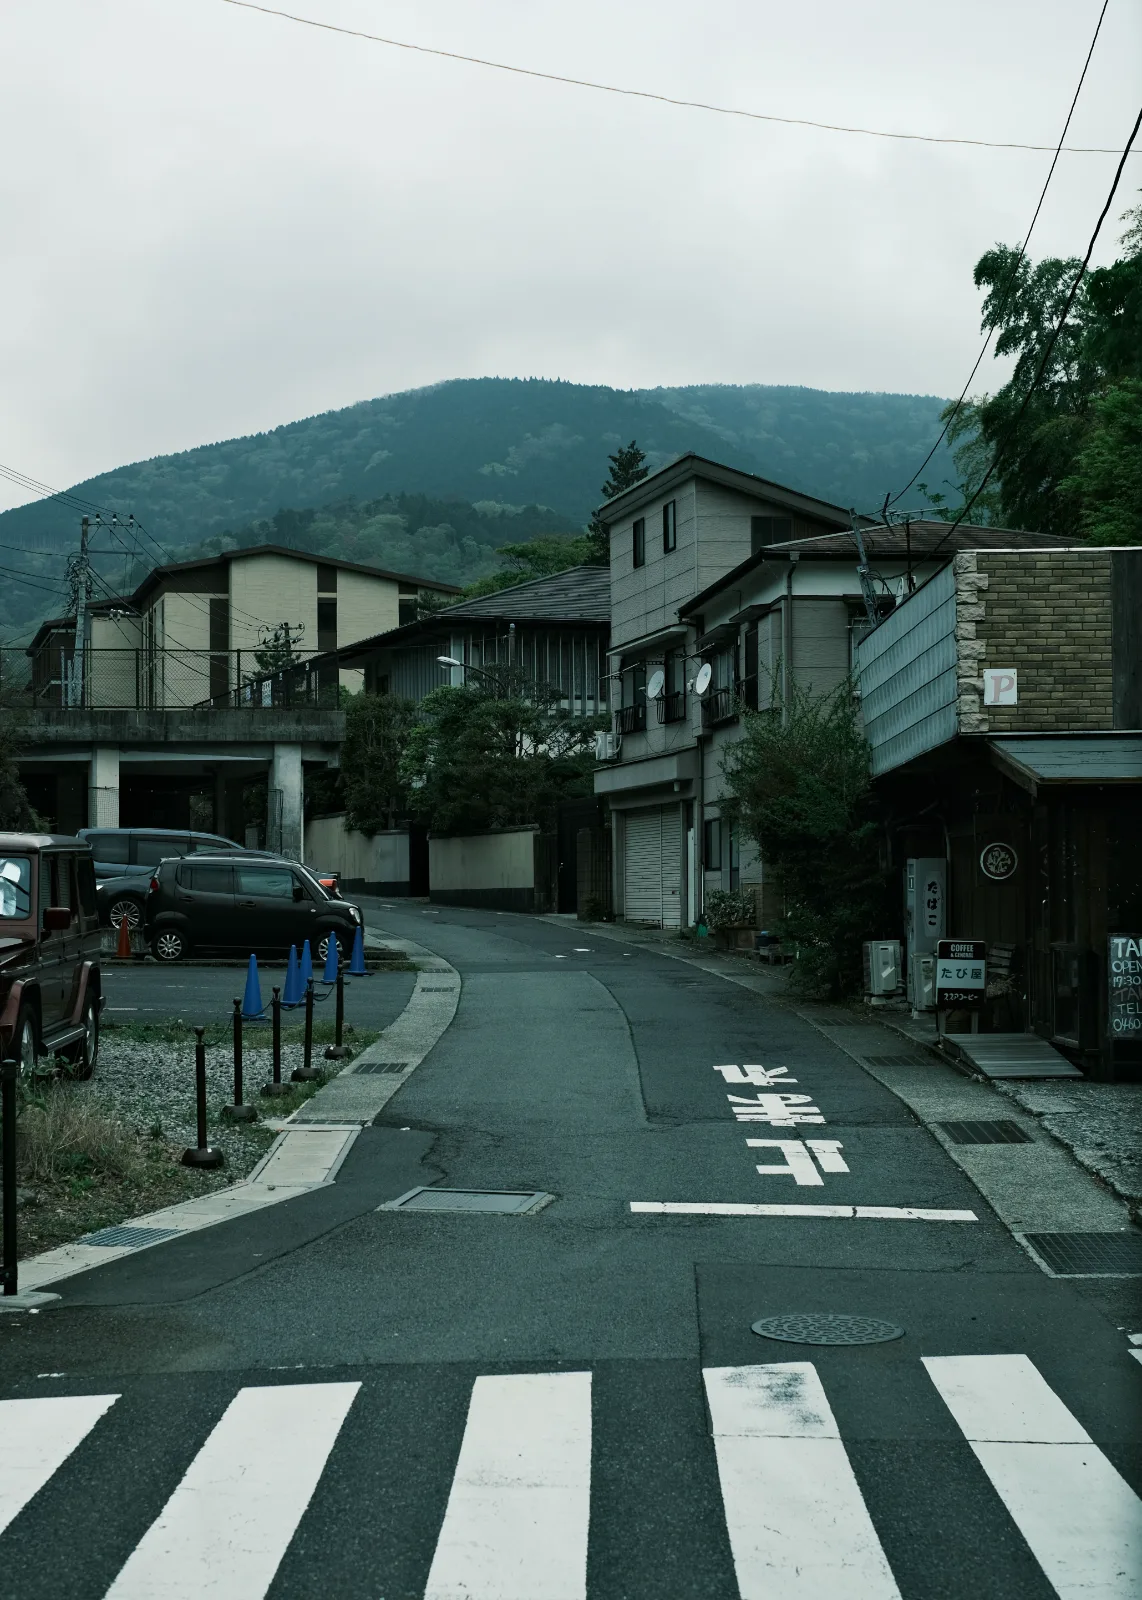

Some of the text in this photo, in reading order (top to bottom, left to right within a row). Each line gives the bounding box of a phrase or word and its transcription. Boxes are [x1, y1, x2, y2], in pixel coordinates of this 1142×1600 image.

[991, 675, 1015, 704] P
[927, 881, 941, 926] たばこ
[950, 944, 974, 952] COFFEE
[1113, 938, 1142, 958] TA
[941, 967, 983, 980] たび屋
[1116, 1002, 1142, 1014] TEL
[712, 1064, 851, 1187] 止まれ
